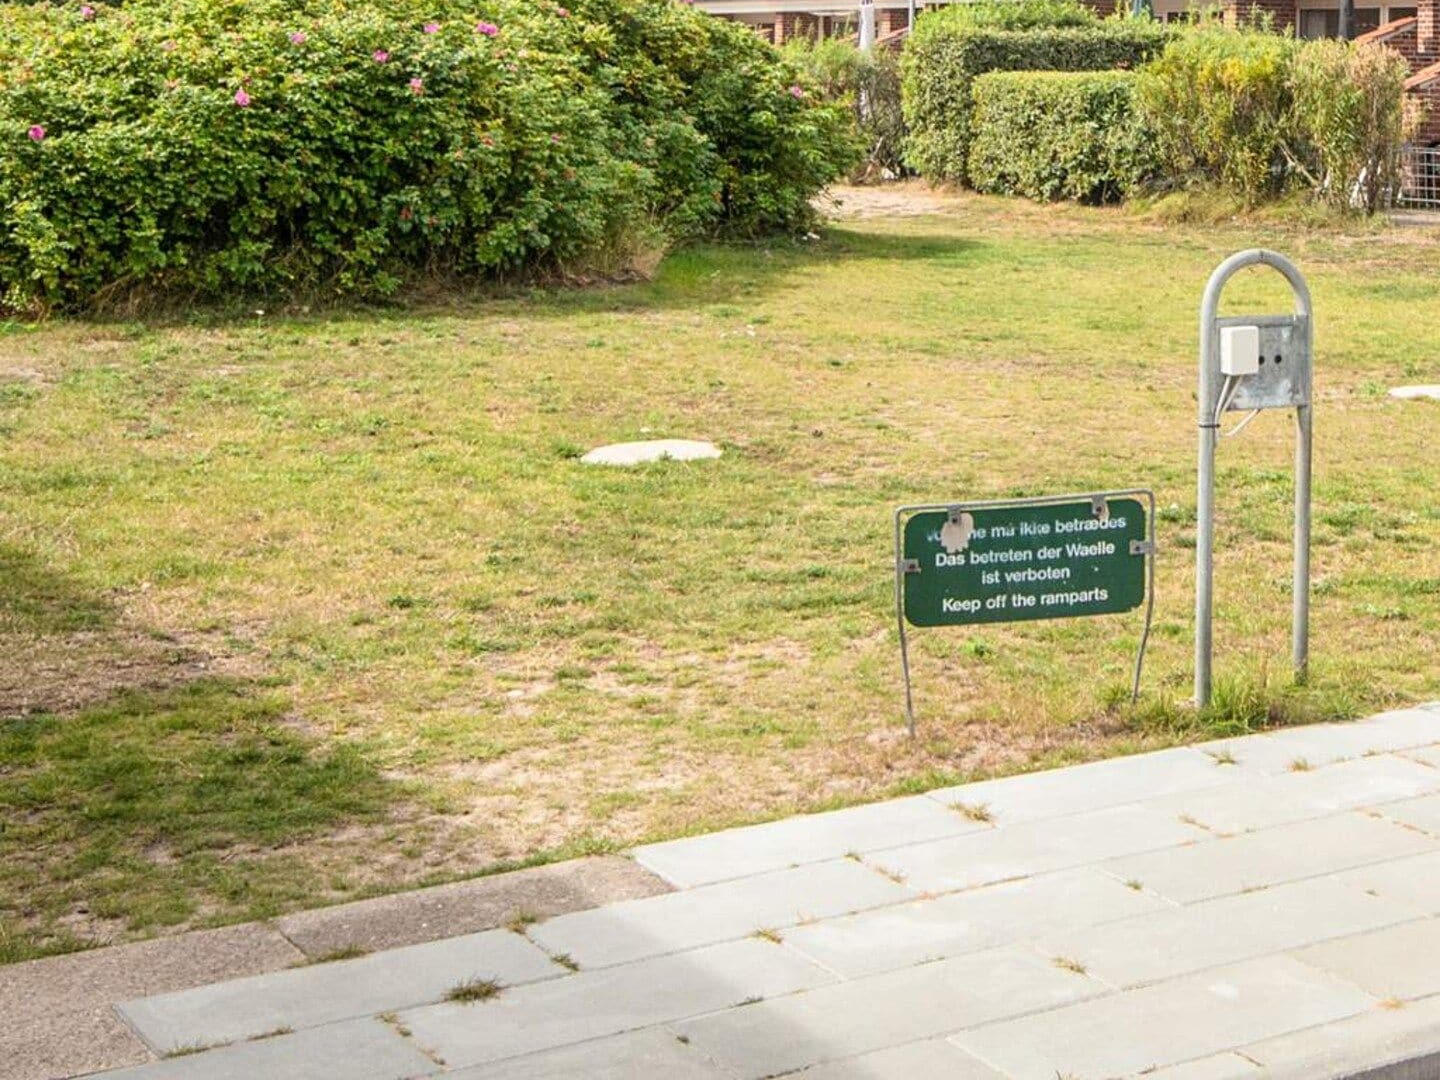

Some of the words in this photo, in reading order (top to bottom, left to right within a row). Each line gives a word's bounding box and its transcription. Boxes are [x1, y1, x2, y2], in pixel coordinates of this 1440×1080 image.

[935, 552, 965, 567] Das
[970, 548, 1032, 565] betreten
[1037, 546, 1062, 560] der
[981, 573, 1000, 584] ist
[1005, 567, 1070, 582] verboten
[942, 598, 981, 613] Keep
[986, 595, 1007, 609] off
[1012, 593, 1036, 607] the
[1040, 587, 1108, 606] ramparts
